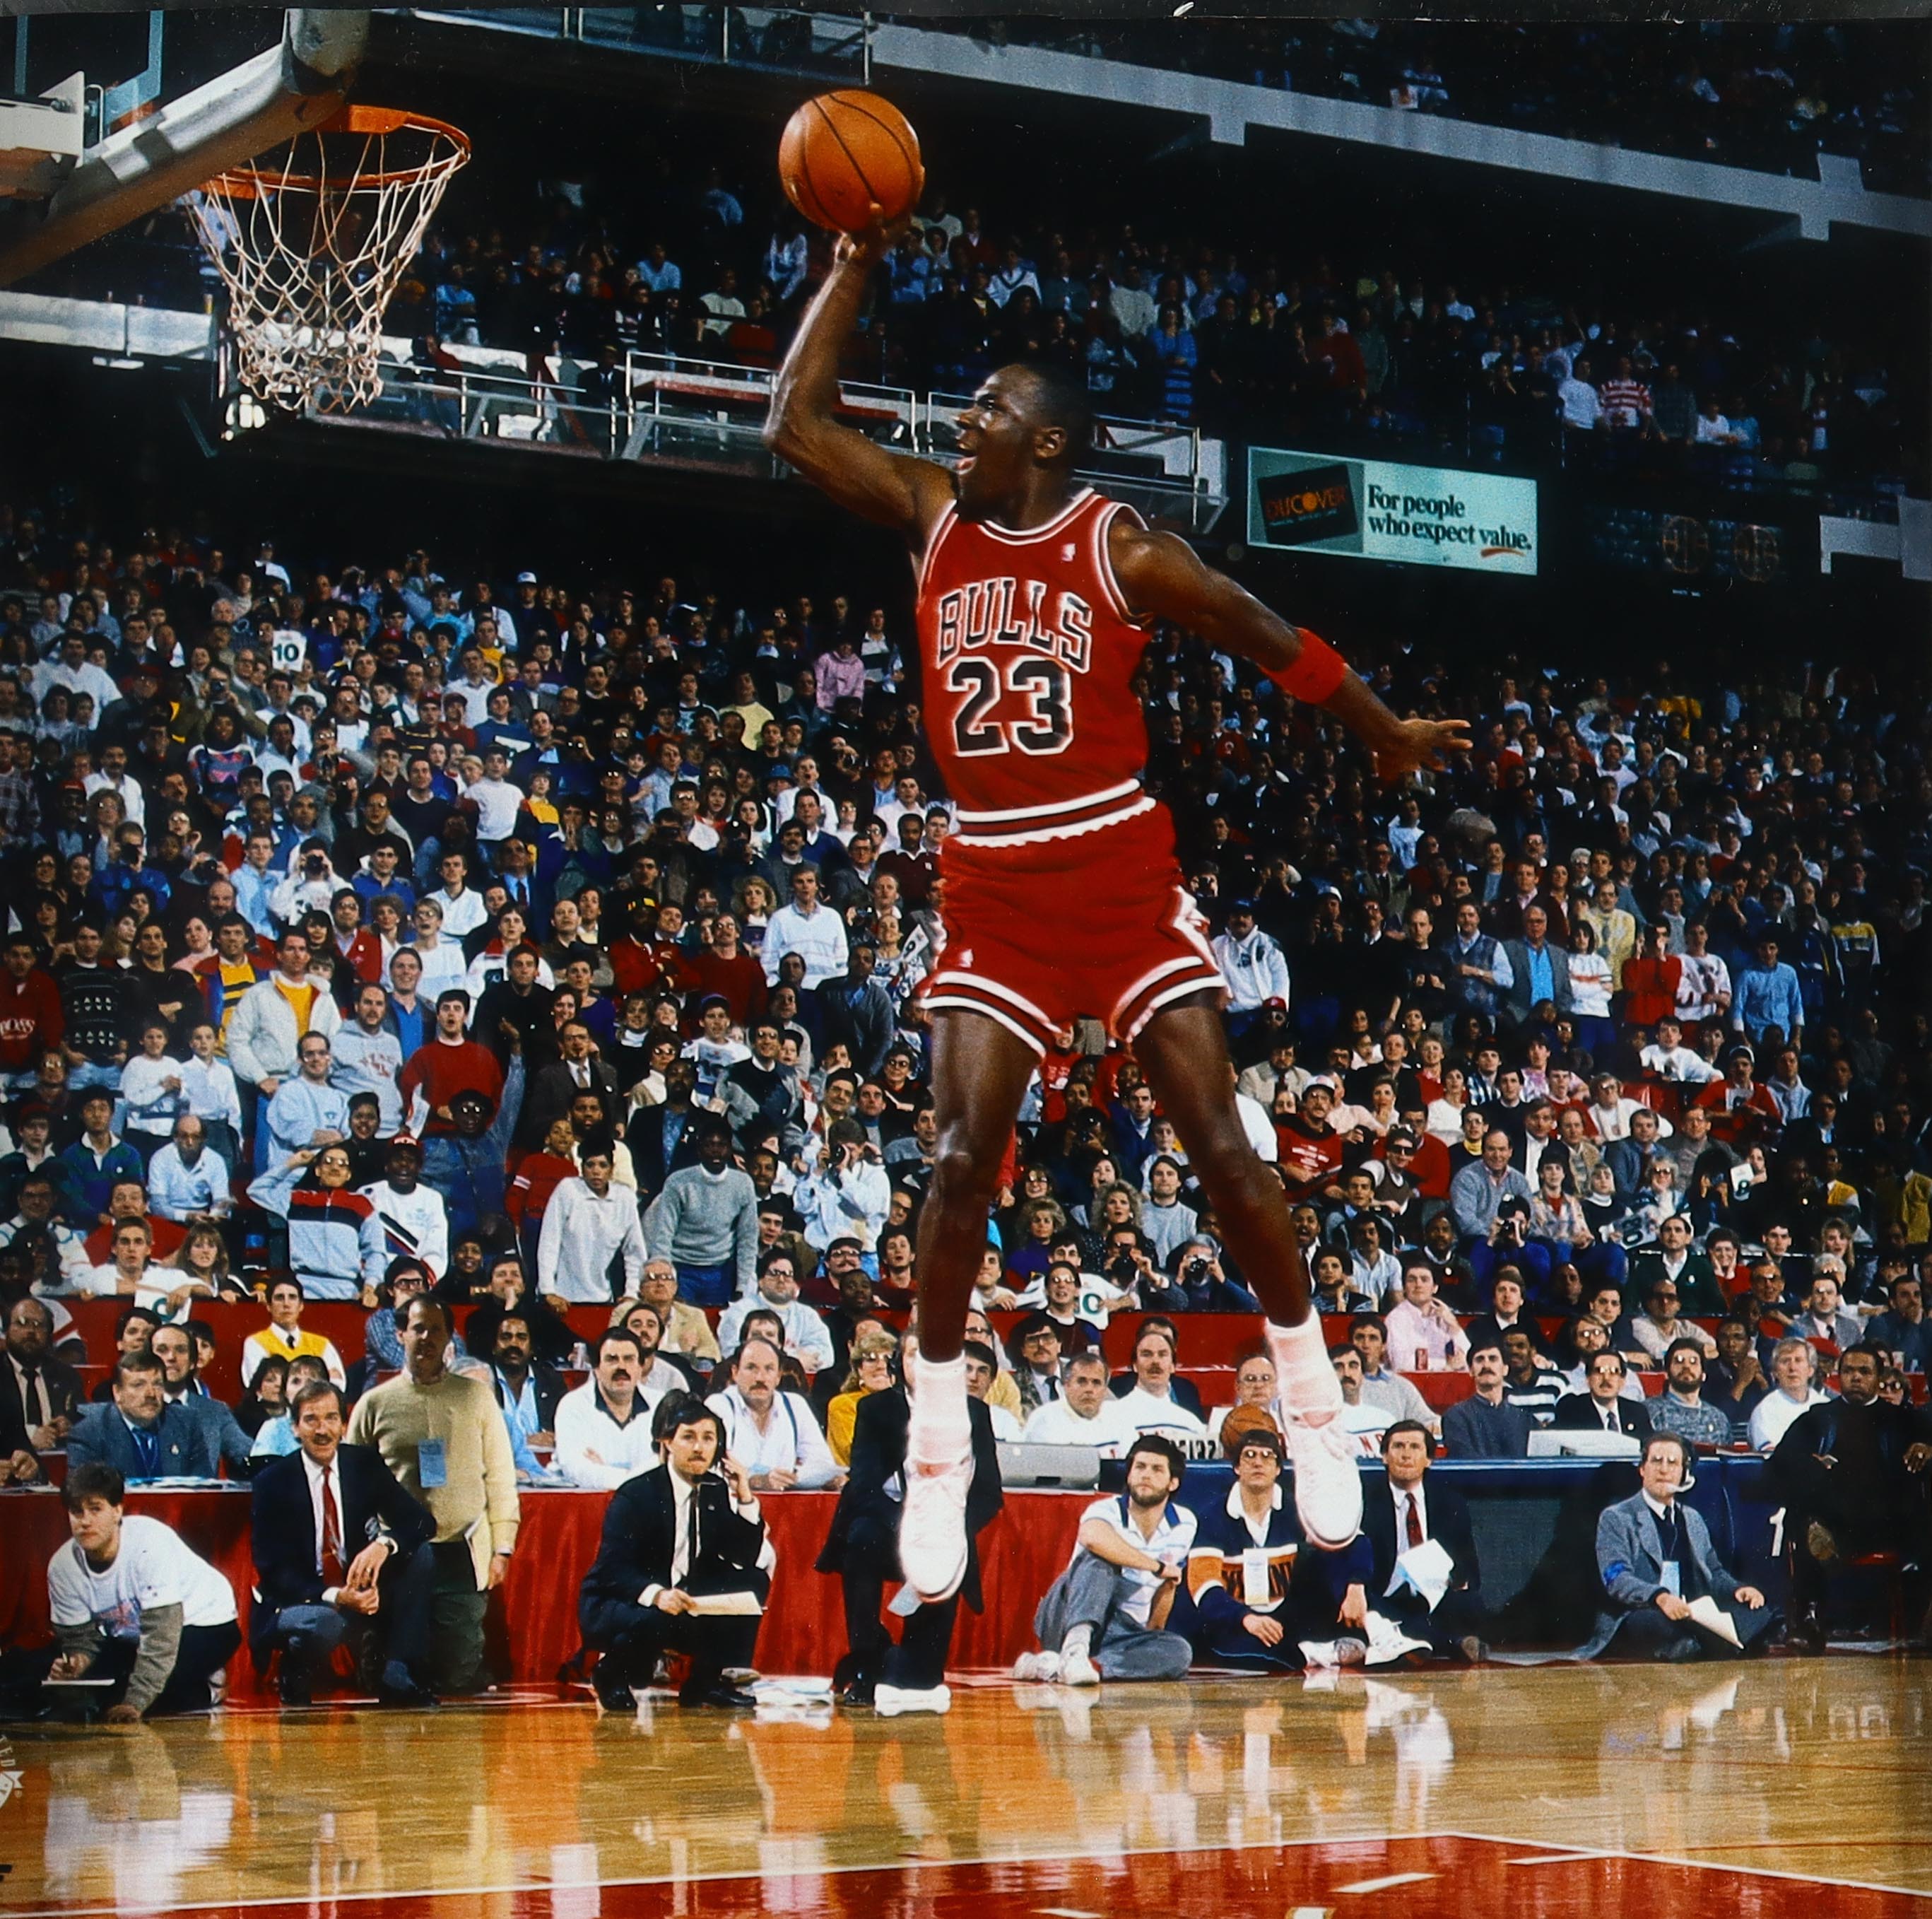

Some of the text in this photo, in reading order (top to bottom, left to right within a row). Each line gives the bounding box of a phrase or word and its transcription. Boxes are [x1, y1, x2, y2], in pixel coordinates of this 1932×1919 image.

[1368, 484, 1466, 520] For people
[1368, 512, 1410, 536] who
[1413, 520, 1475, 545] expect
[1479, 525, 1532, 551] value.
[936, 577, 1093, 674] BULLS
[272, 643, 300, 662] 10
[946, 655, 1074, 758] 23
[1769, 1507, 1787, 1556] 1
